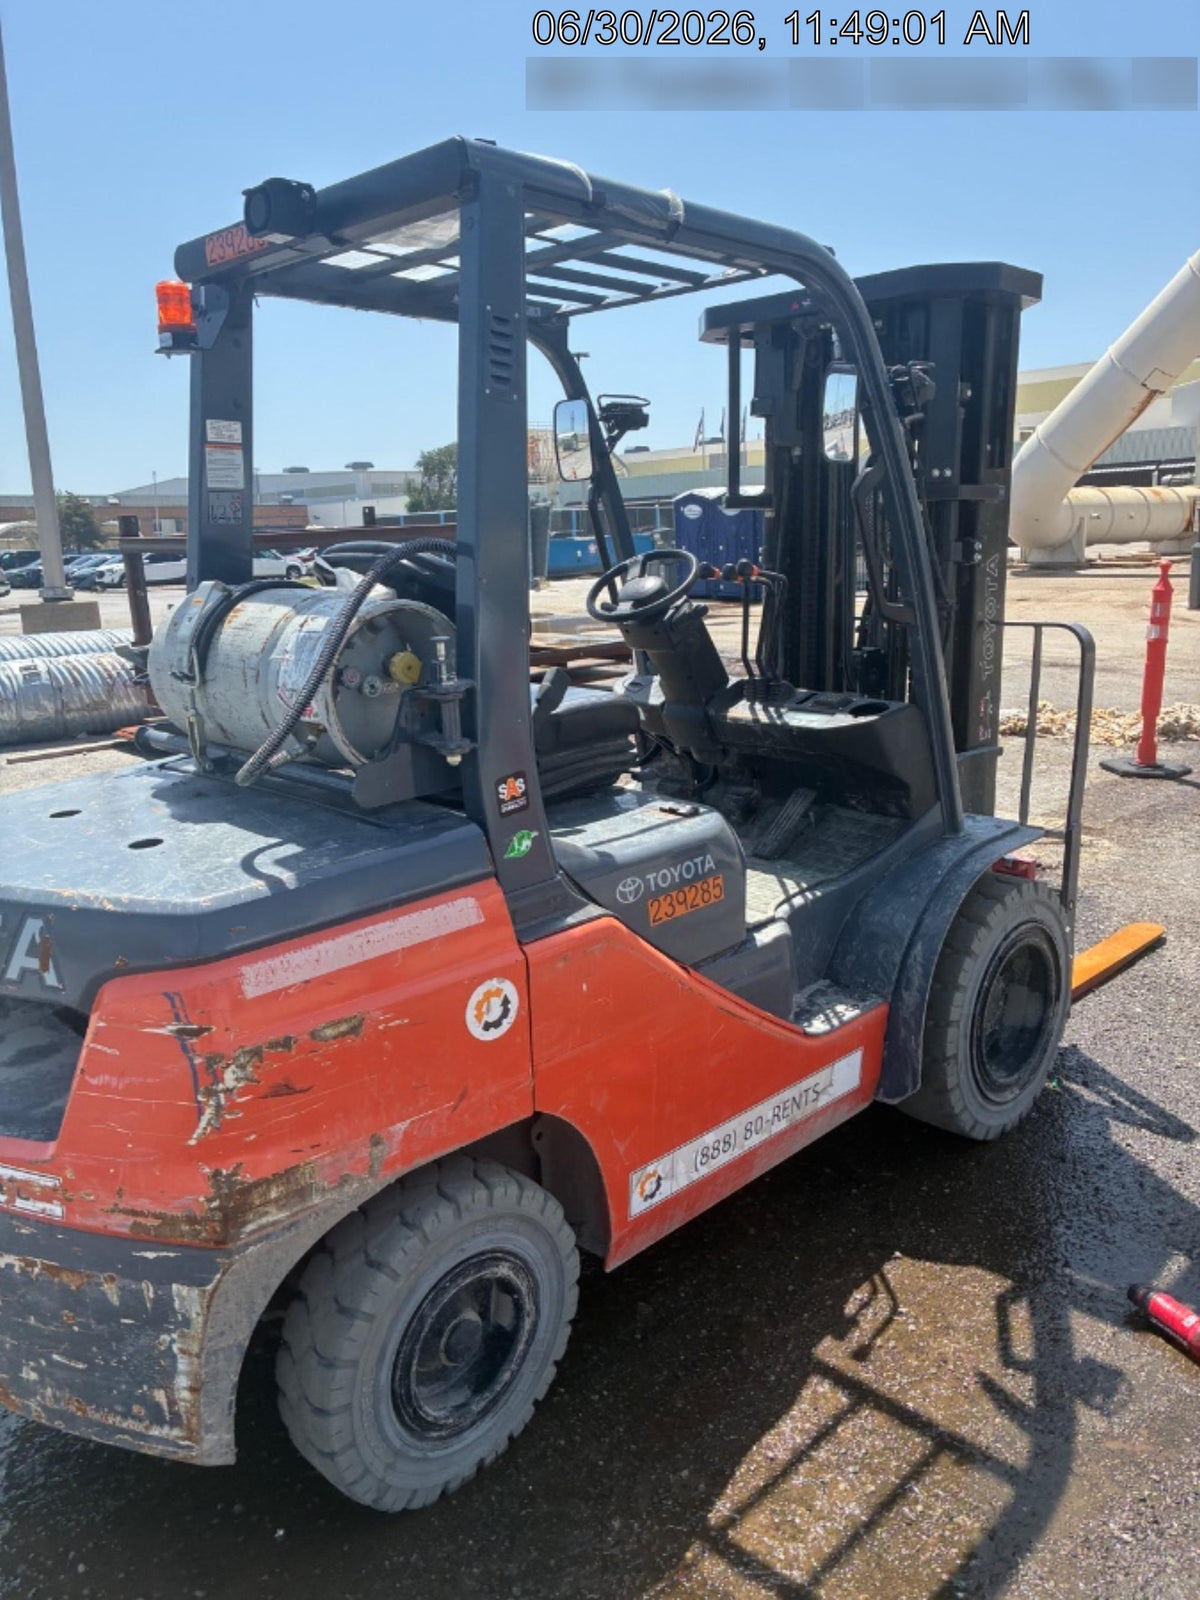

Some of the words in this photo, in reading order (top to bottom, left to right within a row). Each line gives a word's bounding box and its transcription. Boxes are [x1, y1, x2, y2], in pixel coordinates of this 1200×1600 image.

[207, 226, 267, 264] 2392
[981, 553, 998, 681] TOYOTA
[498, 777, 526, 801] SAS
[646, 854, 716, 892] TOYOTA
[650, 875, 723, 923] 239285
[0, 915, 64, 990] A
[694, 1129, 738, 1173] (888)
[743, 1082, 821, 1141] 80-RENTS
